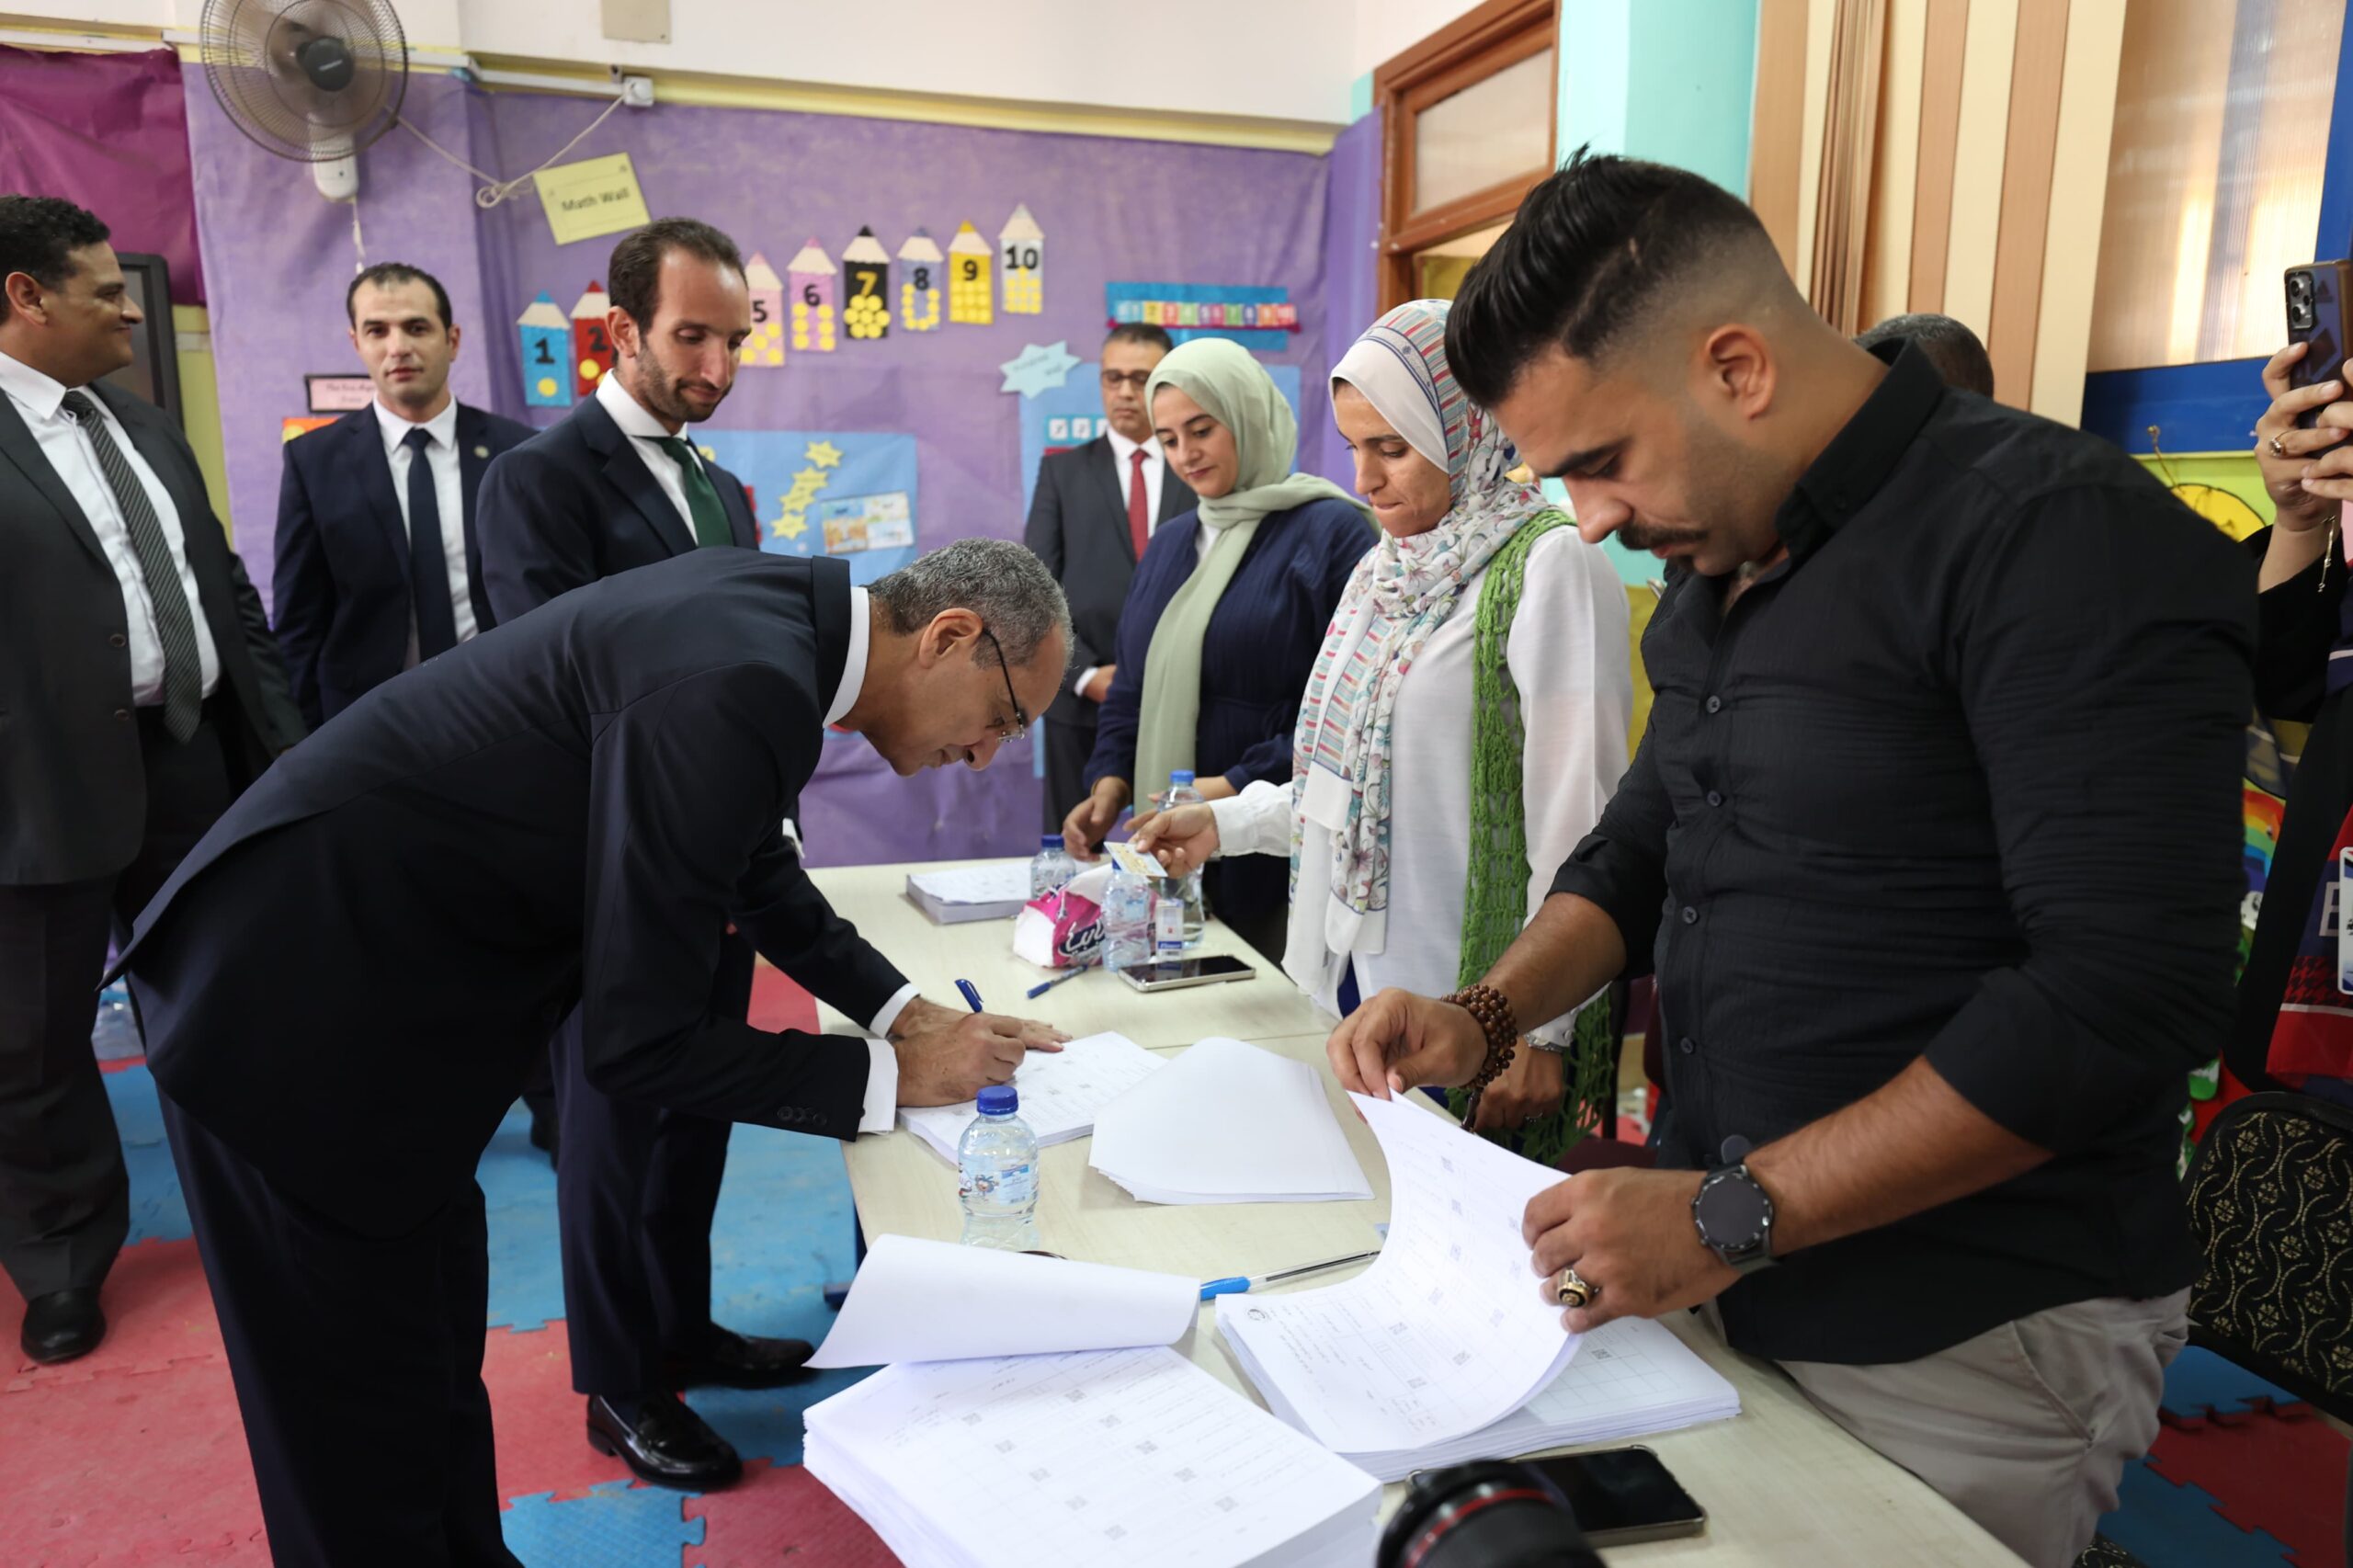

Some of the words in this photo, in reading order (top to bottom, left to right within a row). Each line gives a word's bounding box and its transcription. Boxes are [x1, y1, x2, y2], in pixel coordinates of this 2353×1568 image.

[562, 194, 597, 211] Math
[598, 187, 630, 203] Wall
[1005, 245, 1039, 270] 10
[913, 267, 929, 290] 8
[962, 259, 978, 281] 9
[803, 284, 821, 306] 6
[856, 270, 878, 296] 7
[752, 300, 767, 323] 5
[535, 336, 555, 364] 1
[589, 326, 608, 352] 2
